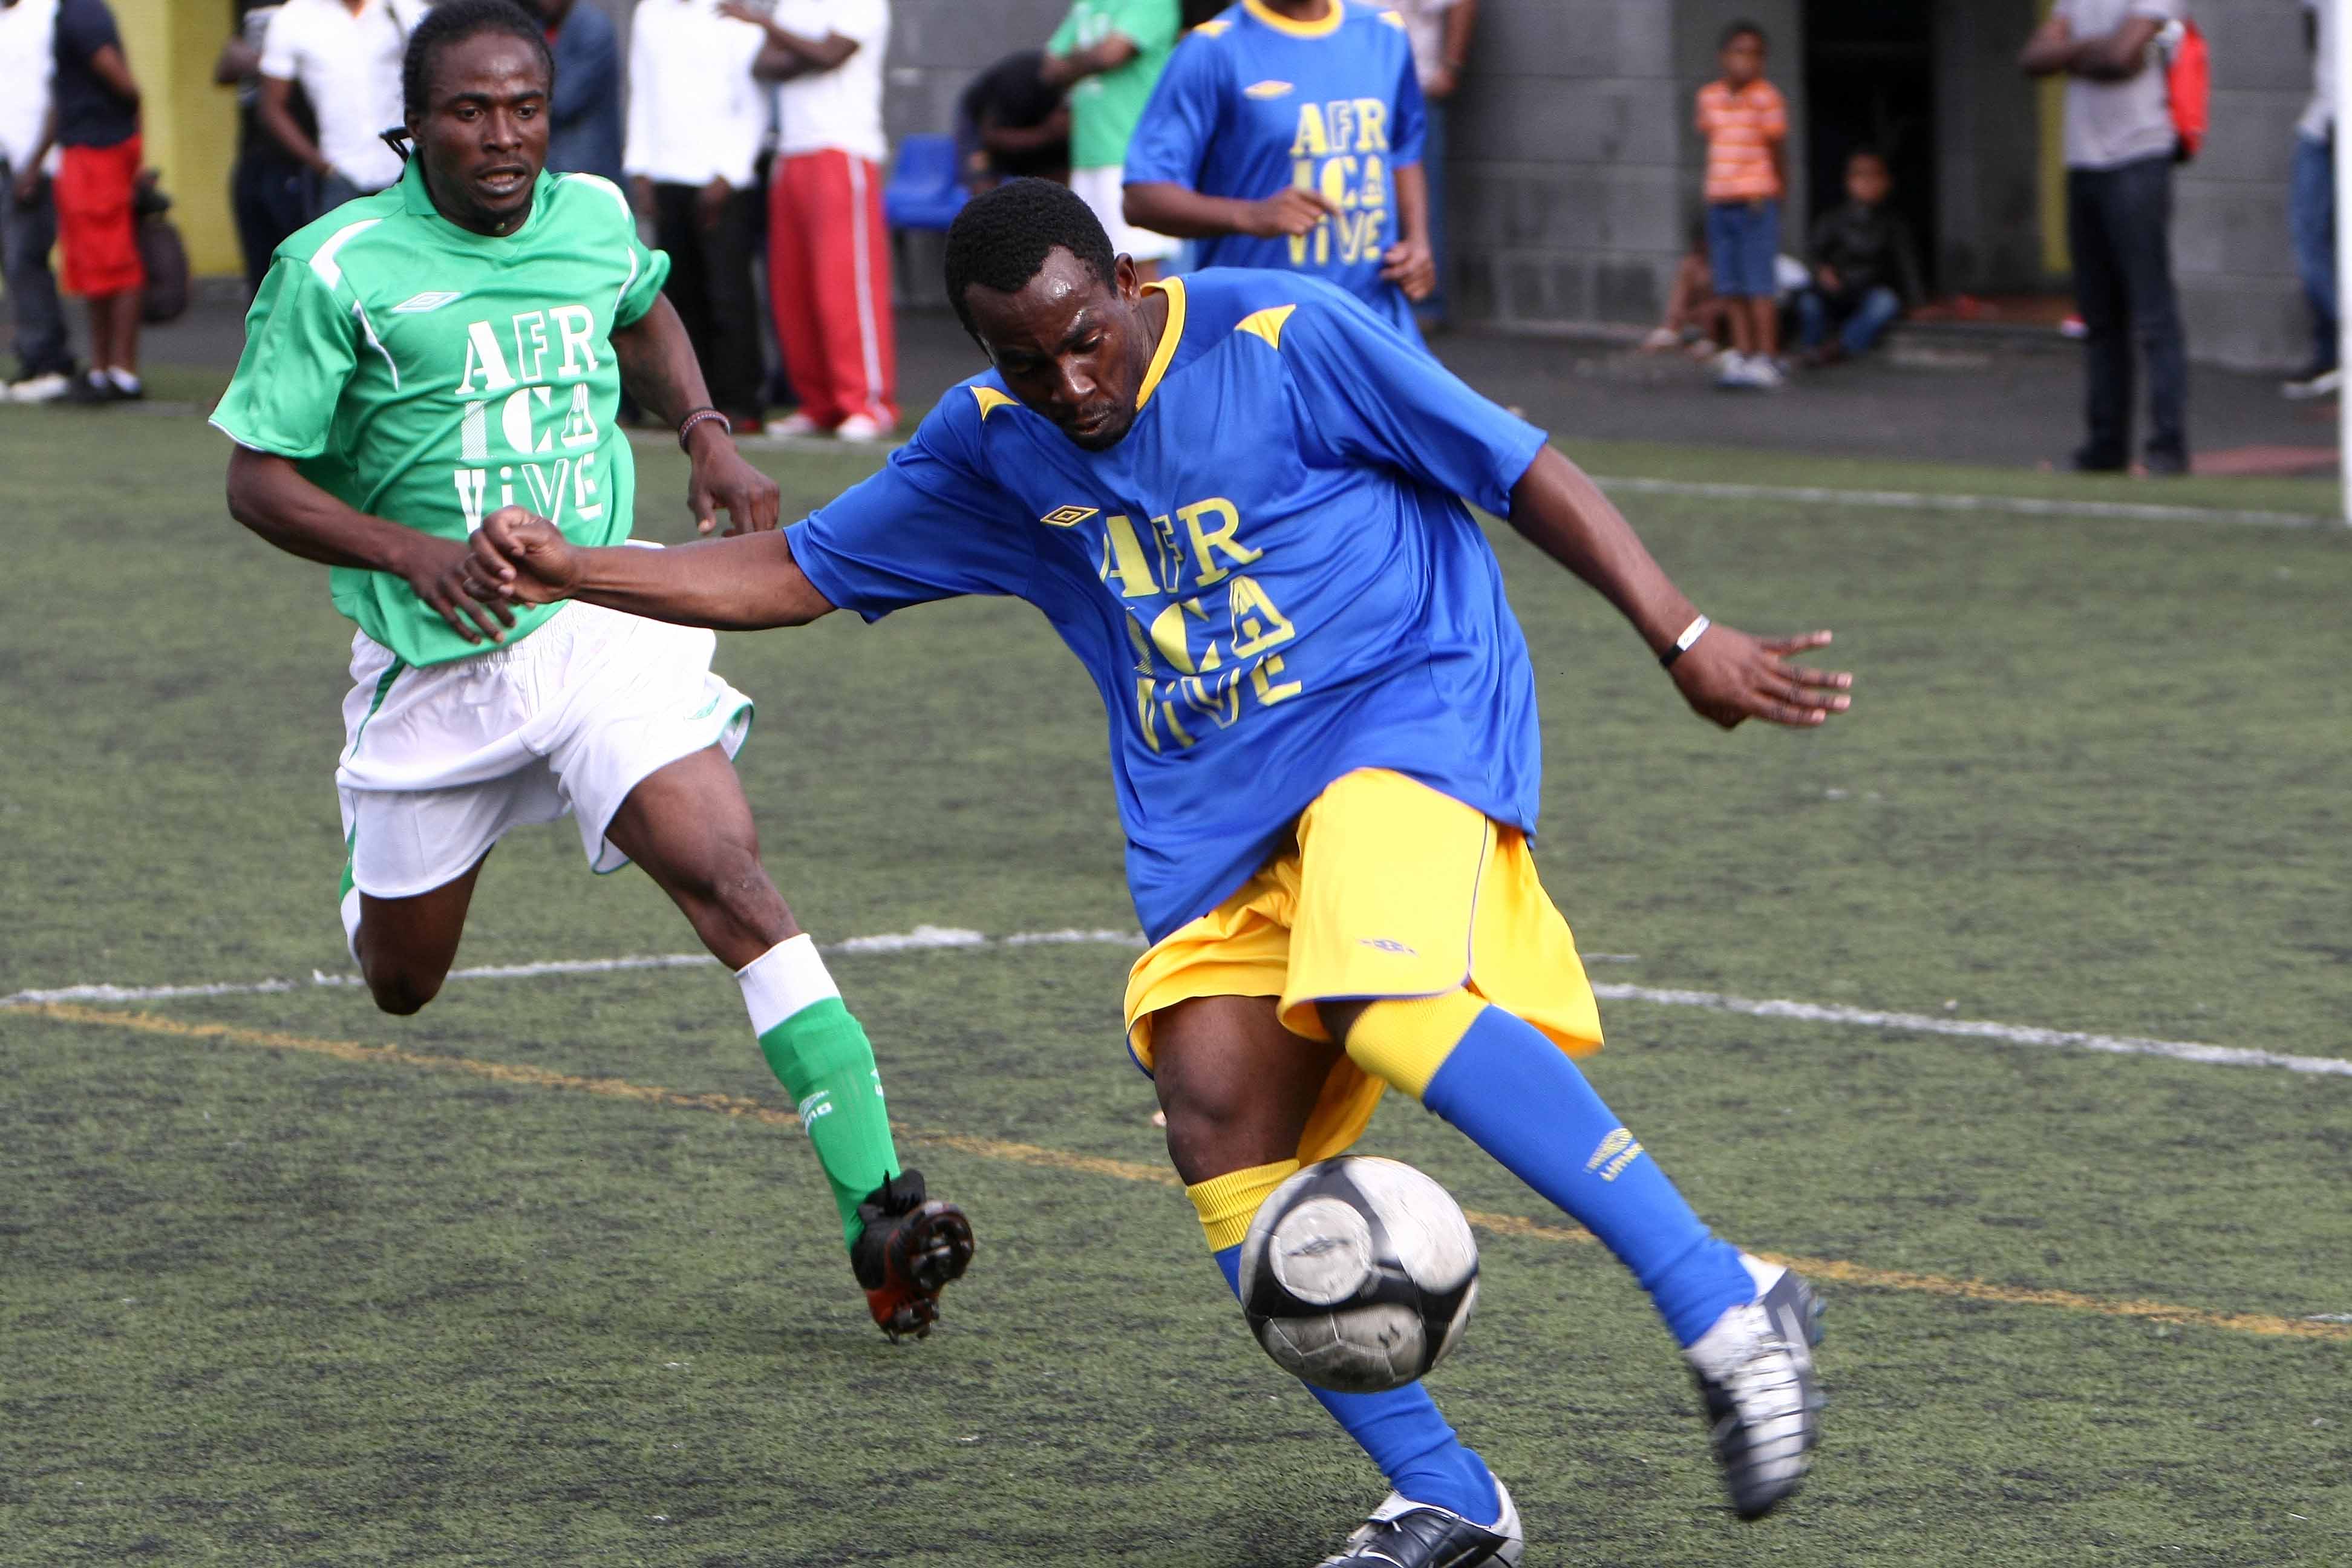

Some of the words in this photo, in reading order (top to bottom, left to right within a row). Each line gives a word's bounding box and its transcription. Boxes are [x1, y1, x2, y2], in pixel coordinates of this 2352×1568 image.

[1290, 97, 1390, 157] AFR
[455, 305, 599, 395] AFR
[456, 382, 598, 461] ICA
[1099, 497, 1264, 598] AFR
[1126, 575, 1296, 676] ICA
